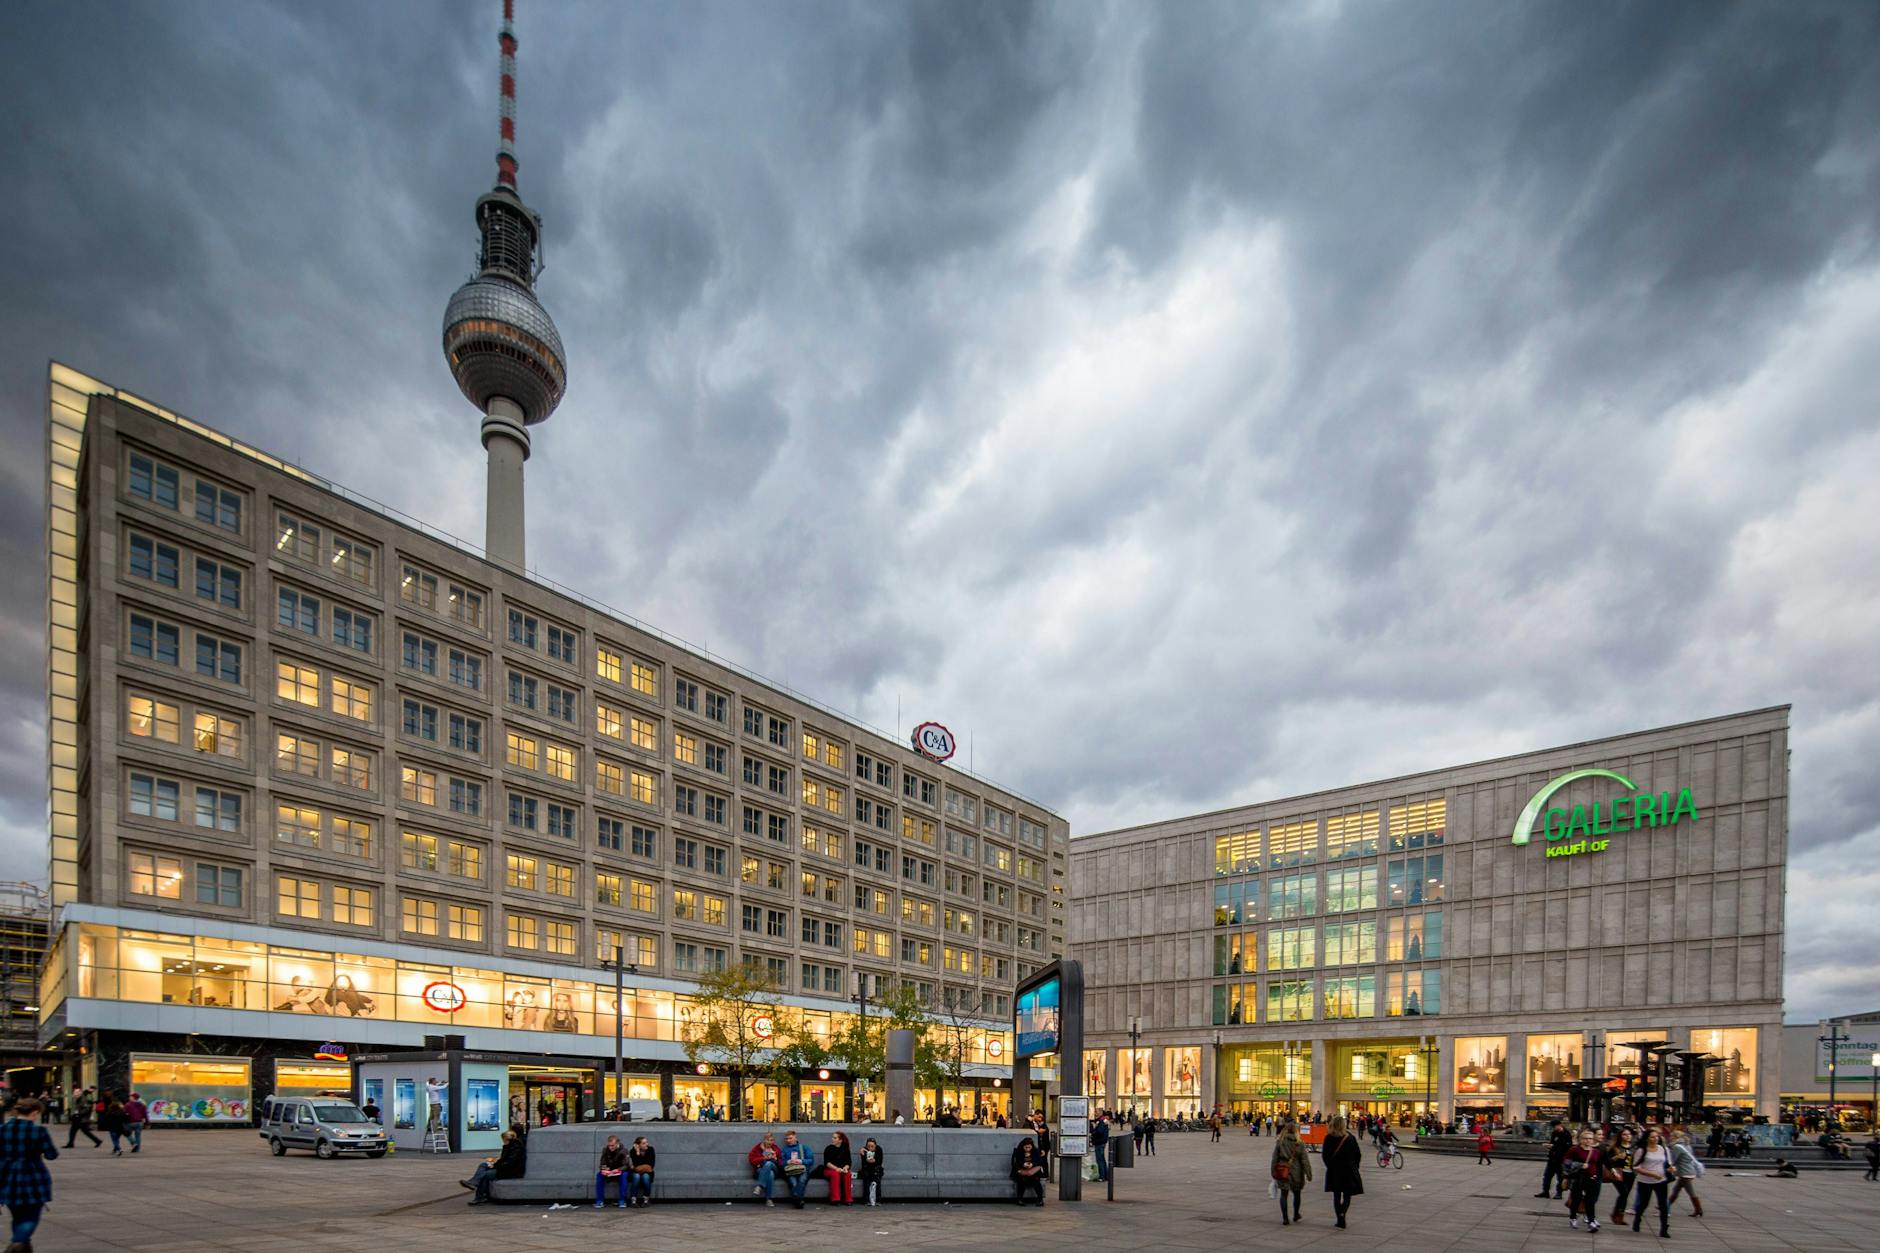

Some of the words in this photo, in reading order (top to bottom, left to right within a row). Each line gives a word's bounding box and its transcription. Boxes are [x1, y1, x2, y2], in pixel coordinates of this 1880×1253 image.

[923, 730, 950, 753] C&A
[1543, 787, 1699, 841] GALERIA
[432, 988, 459, 1004] C&A
